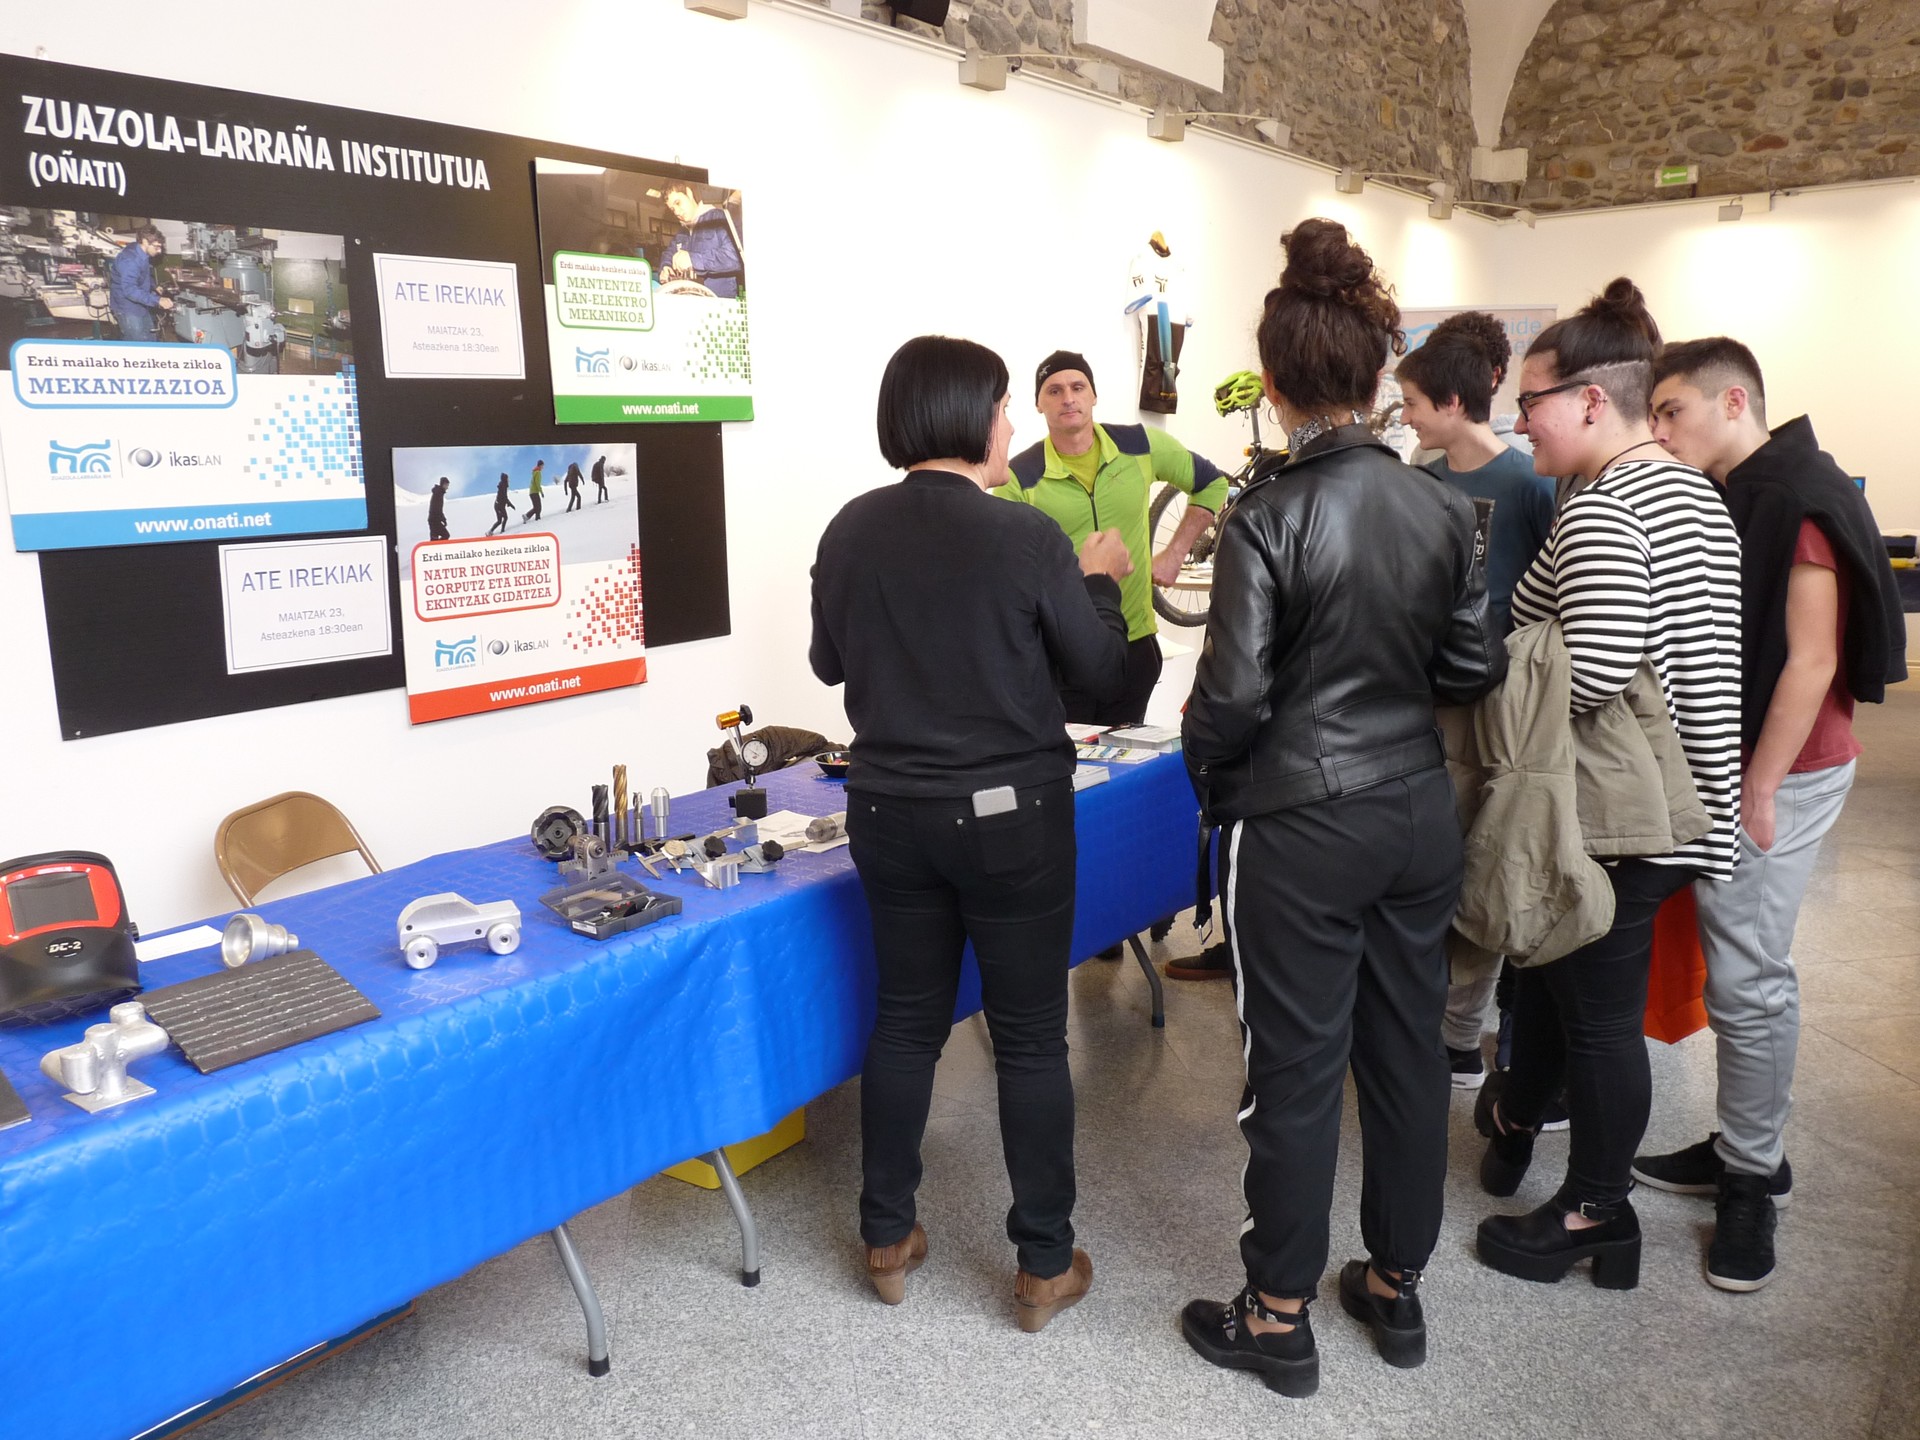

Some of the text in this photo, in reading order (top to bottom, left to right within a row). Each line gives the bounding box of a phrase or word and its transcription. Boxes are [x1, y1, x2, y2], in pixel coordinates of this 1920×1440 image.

[21, 94, 491, 191] ZUAZOLA-LARRAÑA INSTITUTUA
[29, 149, 127, 196] (OÑATI)
[560, 260, 646, 276] Erdi mailako heziketa zikloa
[566, 275, 642, 293] MANTENTZE
[394, 282, 506, 307] ATE IREKIAK
[563, 292, 647, 309] LAN-ELEKTRO
[568, 308, 645, 323] MEKANIKOA
[427, 324, 468, 337] MAIATZAK
[412, 341, 500, 354] Asteazkena 18:30ean
[28, 355, 222, 371] Erdi mailako heziketa zikloa
[29, 377, 226, 396] MEKANIZAZIOA
[622, 401, 699, 416] www.onati.net
[135, 512, 272, 534] www.onati.net
[422, 543, 550, 563] Erdi mailako heziketa zikloa
[241, 563, 373, 593] ATE IREKIAK
[424, 559, 550, 582] NATUR INGURUNEAN
[425, 573, 551, 597] GORPUTZ ETA KIROL
[425, 587, 552, 612] EKINTZAK GIDATZEA
[279, 609, 327, 623] MAIATZAK
[260, 623, 363, 642] Asteazkena 18:30ean
[489, 675, 581, 702] www.onati.net
[49, 941, 82, 953] DC-2
